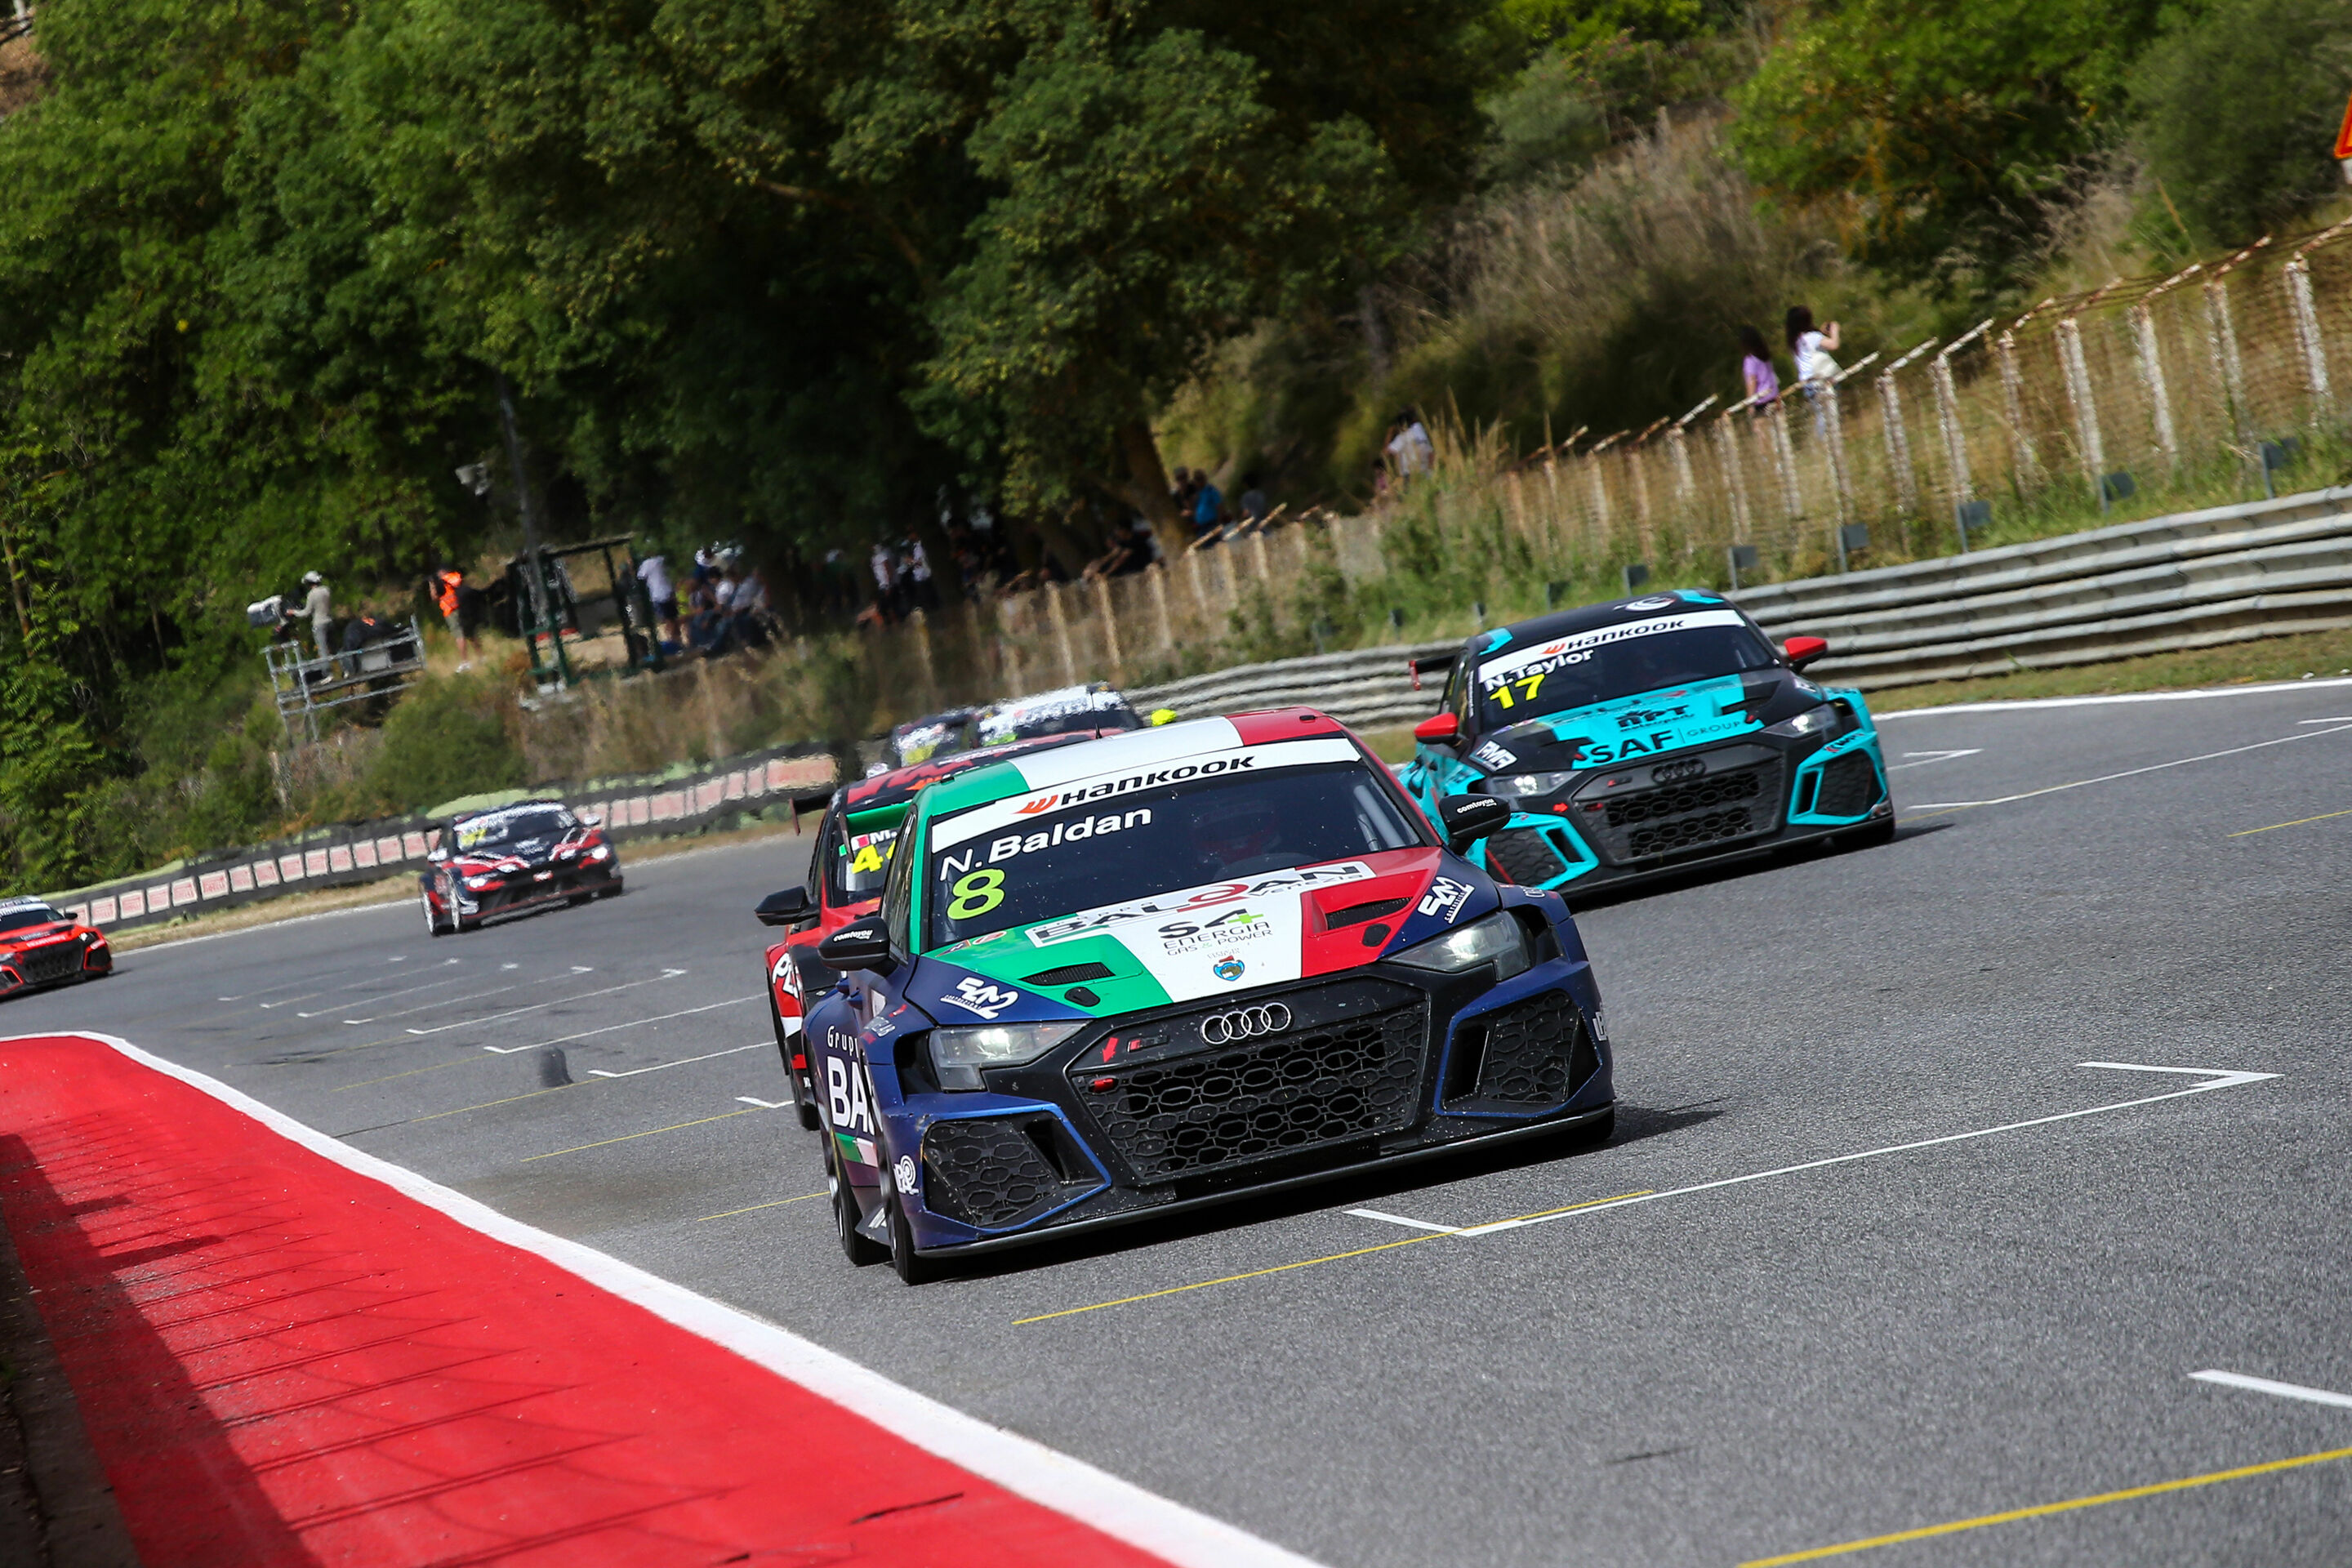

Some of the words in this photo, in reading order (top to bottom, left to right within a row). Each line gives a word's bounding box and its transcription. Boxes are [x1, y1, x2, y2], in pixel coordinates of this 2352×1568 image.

[1489, 672, 1546, 710] 17
[1589, 728, 1674, 764] SAF
[1687, 719, 1741, 737] GROUP
[1456, 798, 1494, 813] comtoyou
[946, 867, 1006, 920] 8
[1167, 945, 1198, 956] GAS
[1217, 929, 1273, 946] POWER
